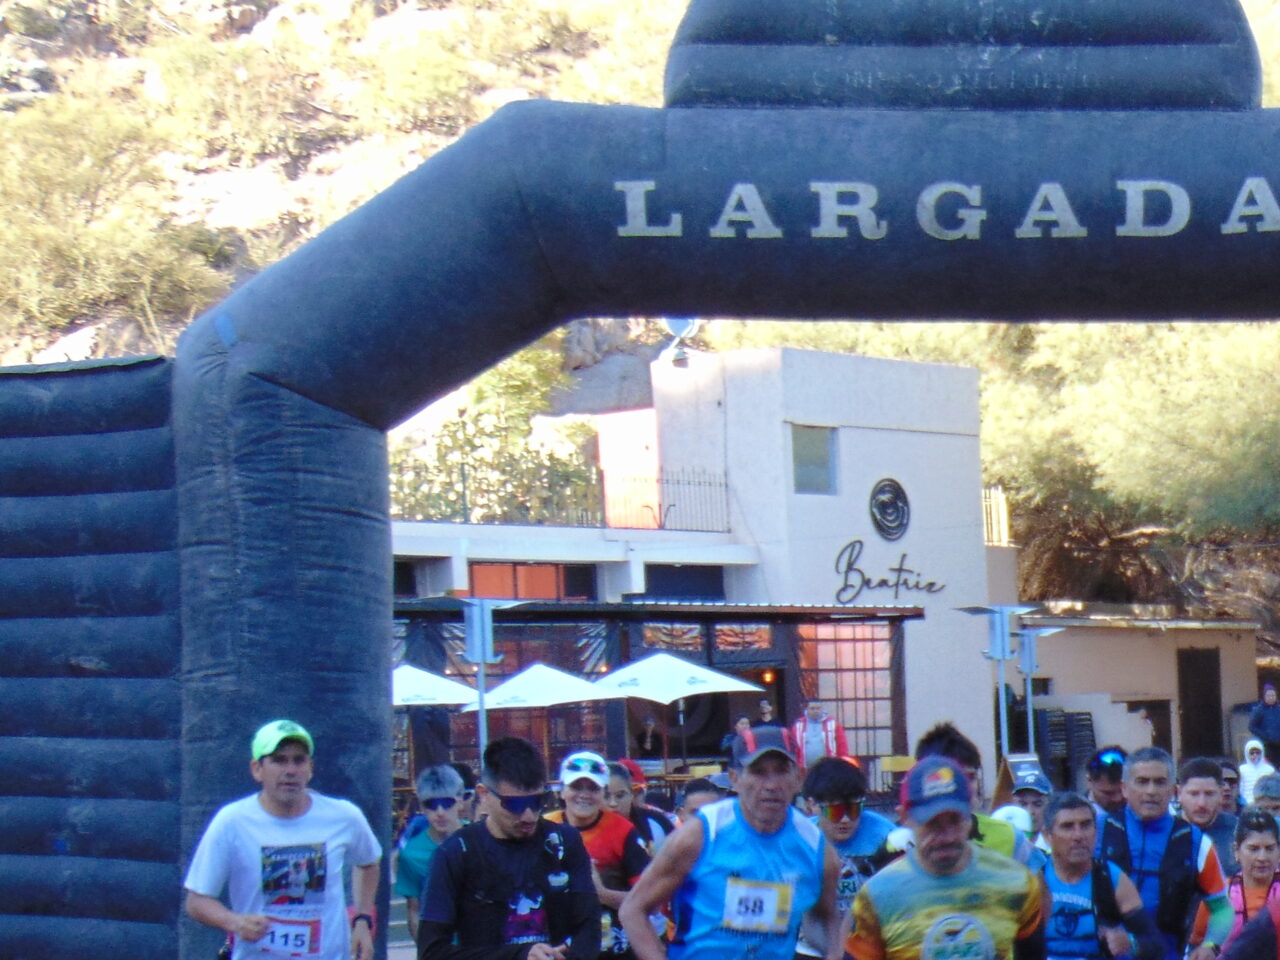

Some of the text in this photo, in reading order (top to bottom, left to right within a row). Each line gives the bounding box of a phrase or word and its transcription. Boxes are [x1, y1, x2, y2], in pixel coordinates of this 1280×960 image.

[835, 539, 946, 604] Beatriz
[736, 896, 765, 916] 58
[267, 930, 306, 948] 115
